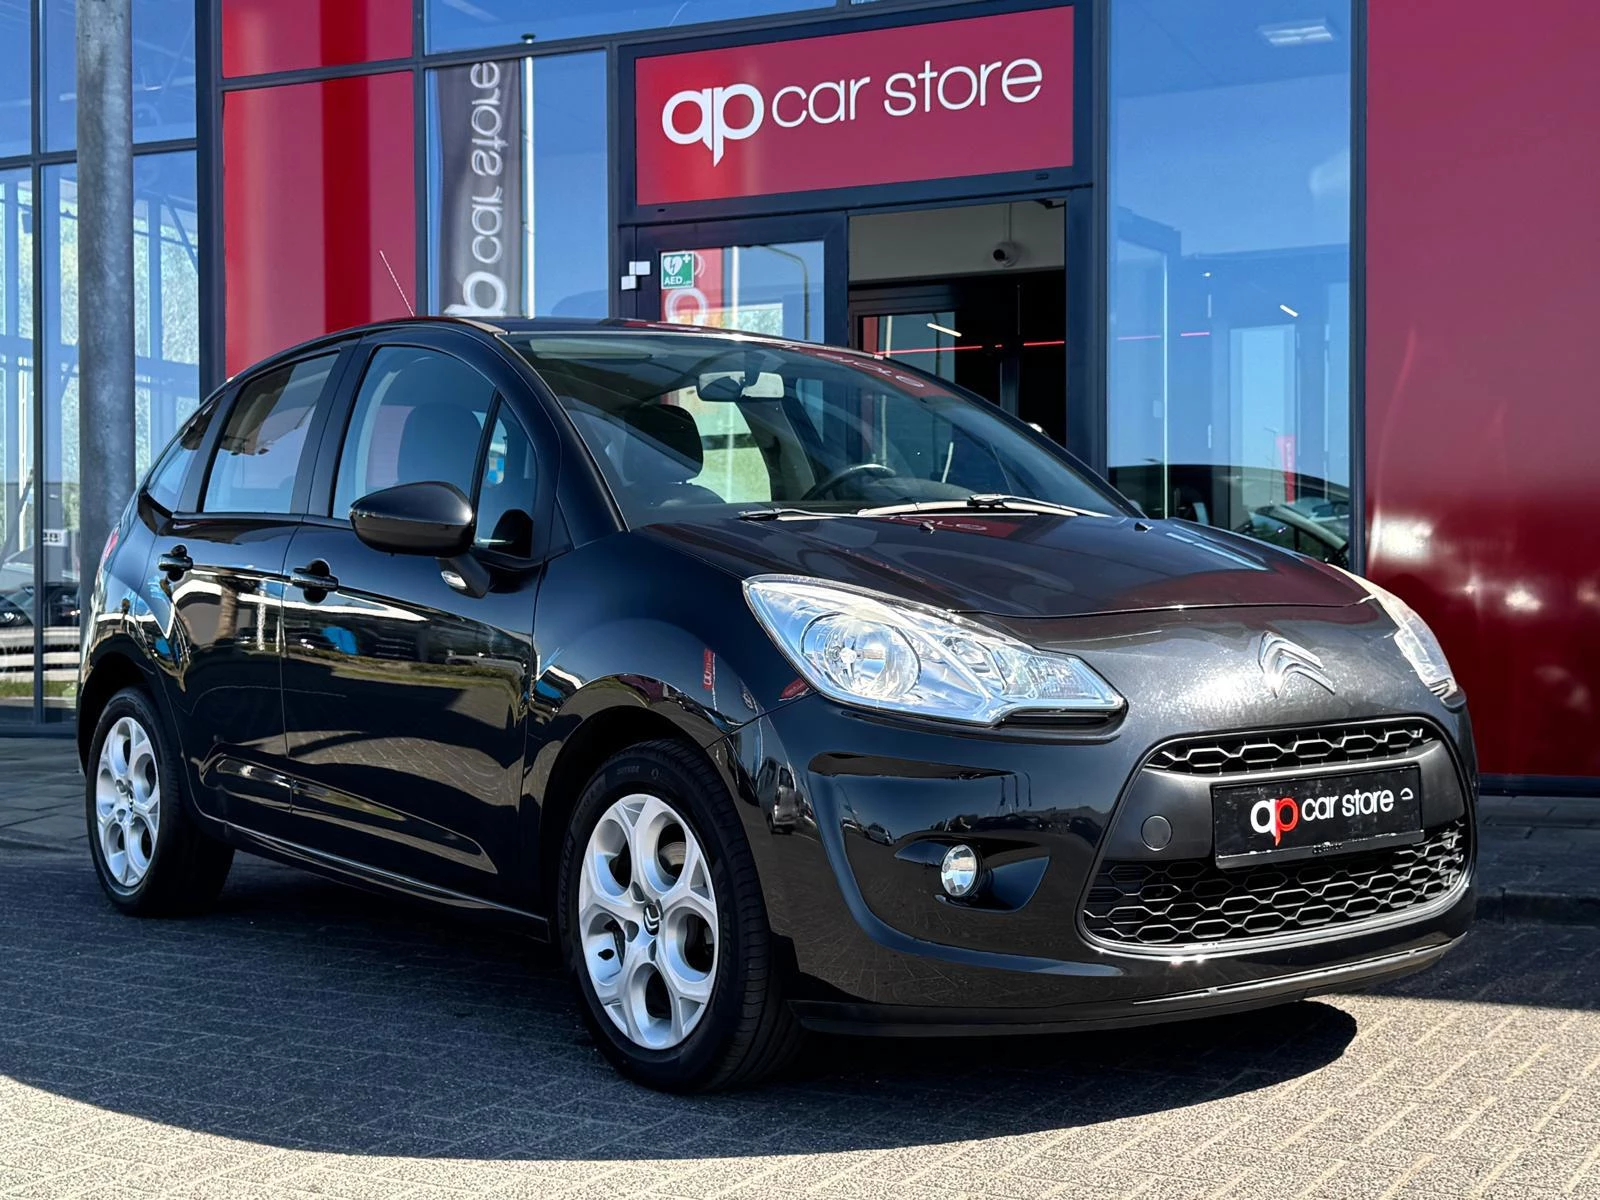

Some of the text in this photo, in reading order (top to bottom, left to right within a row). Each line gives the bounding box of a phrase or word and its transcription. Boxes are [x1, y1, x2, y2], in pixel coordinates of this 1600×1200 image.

[661, 58, 1043, 168] ap car store
[664, 276, 683, 285] AED
[1250, 788, 1395, 847] ap car store
